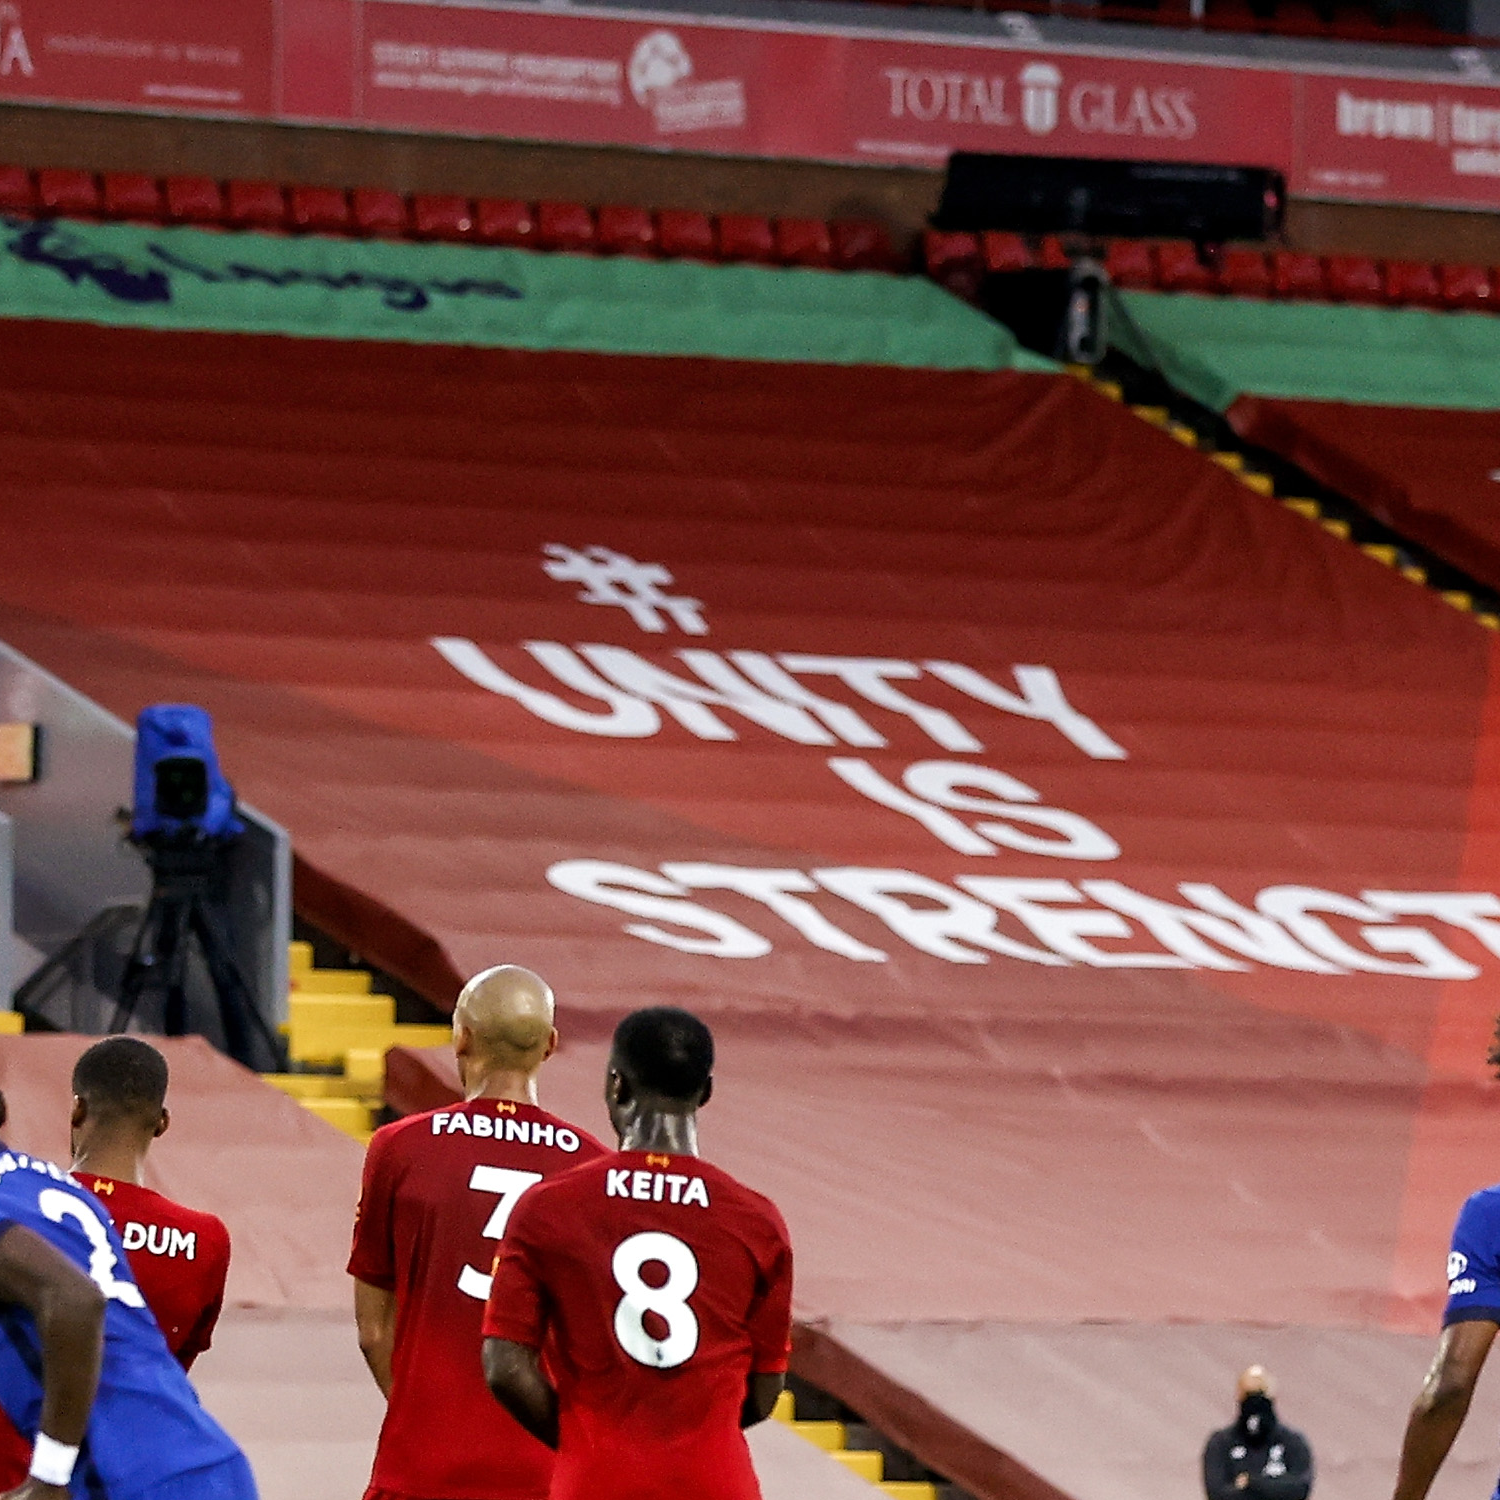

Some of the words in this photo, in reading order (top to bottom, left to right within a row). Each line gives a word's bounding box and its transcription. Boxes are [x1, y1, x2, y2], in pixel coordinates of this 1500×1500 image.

[884, 67, 1012, 127] TOTAL
[1069, 86, 1197, 139] GLASS
[431, 636, 1126, 761] UNITY
[827, 757, 1121, 861] IS
[431, 1112, 581, 1153] FABINHO
[605, 1168, 711, 1208] KEITA
[122, 1221, 196, 1261] DUM
[611, 1230, 700, 1369] 8
